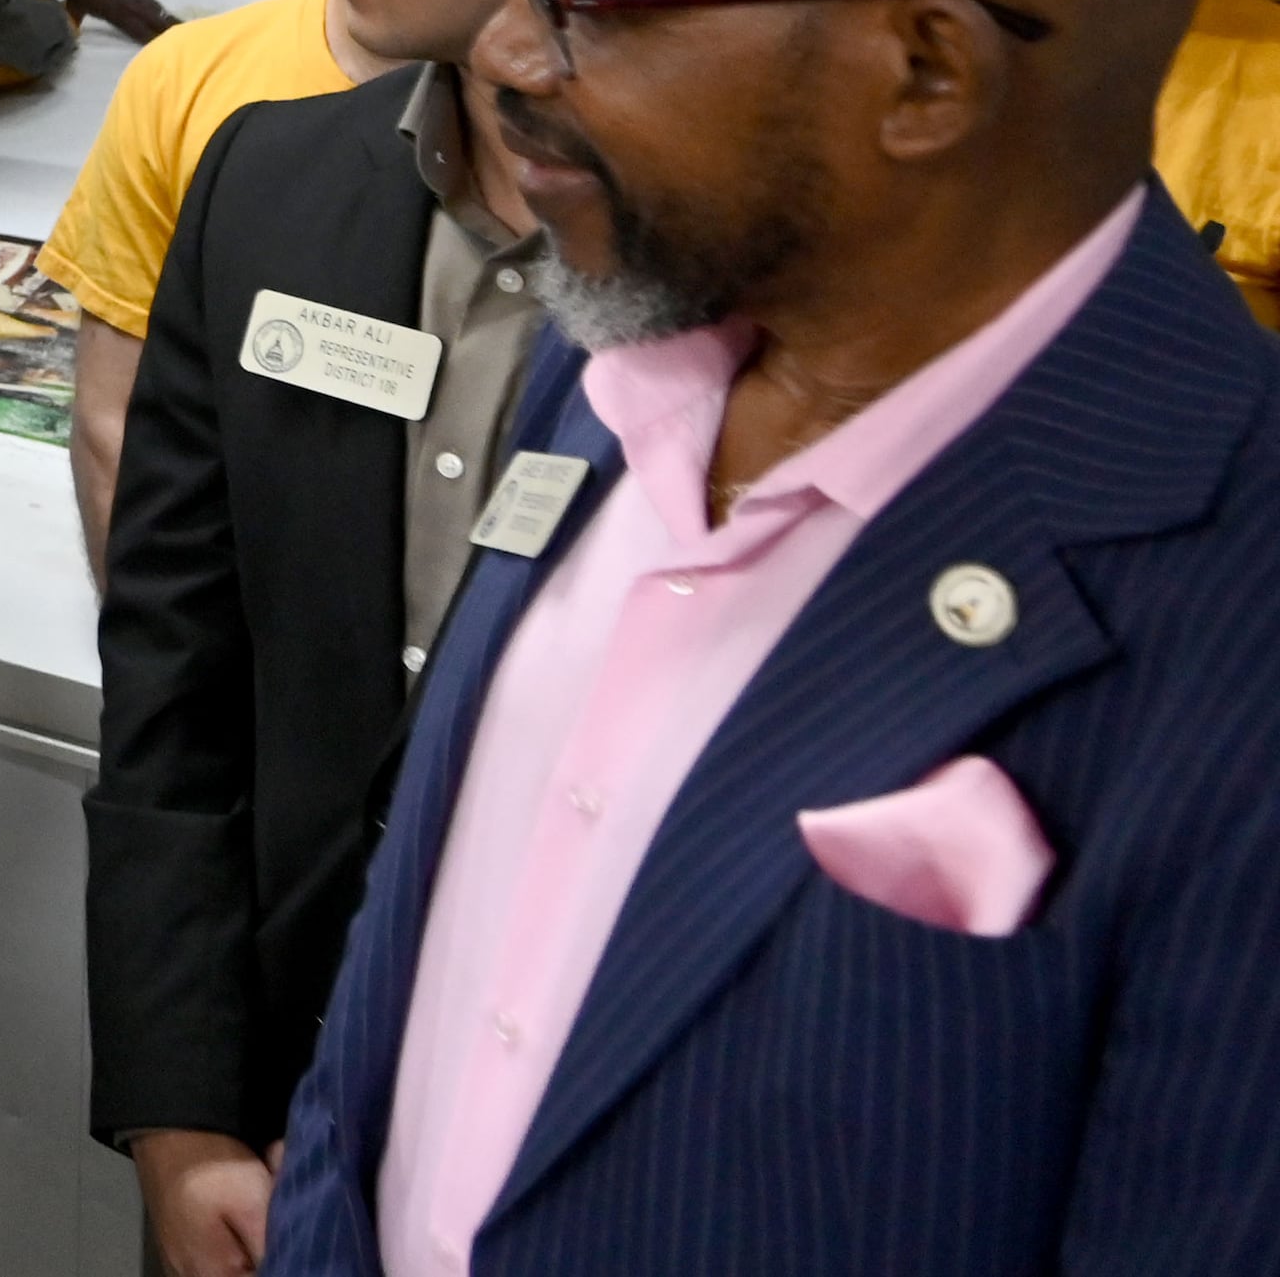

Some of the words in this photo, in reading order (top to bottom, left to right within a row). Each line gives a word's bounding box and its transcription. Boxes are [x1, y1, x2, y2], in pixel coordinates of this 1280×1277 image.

[298, 307, 357, 335] AKBAR
[363, 326, 393, 345] ALI
[319, 339, 415, 379] REPRESENTATIVE
[325, 362, 376, 388] DISTRICT
